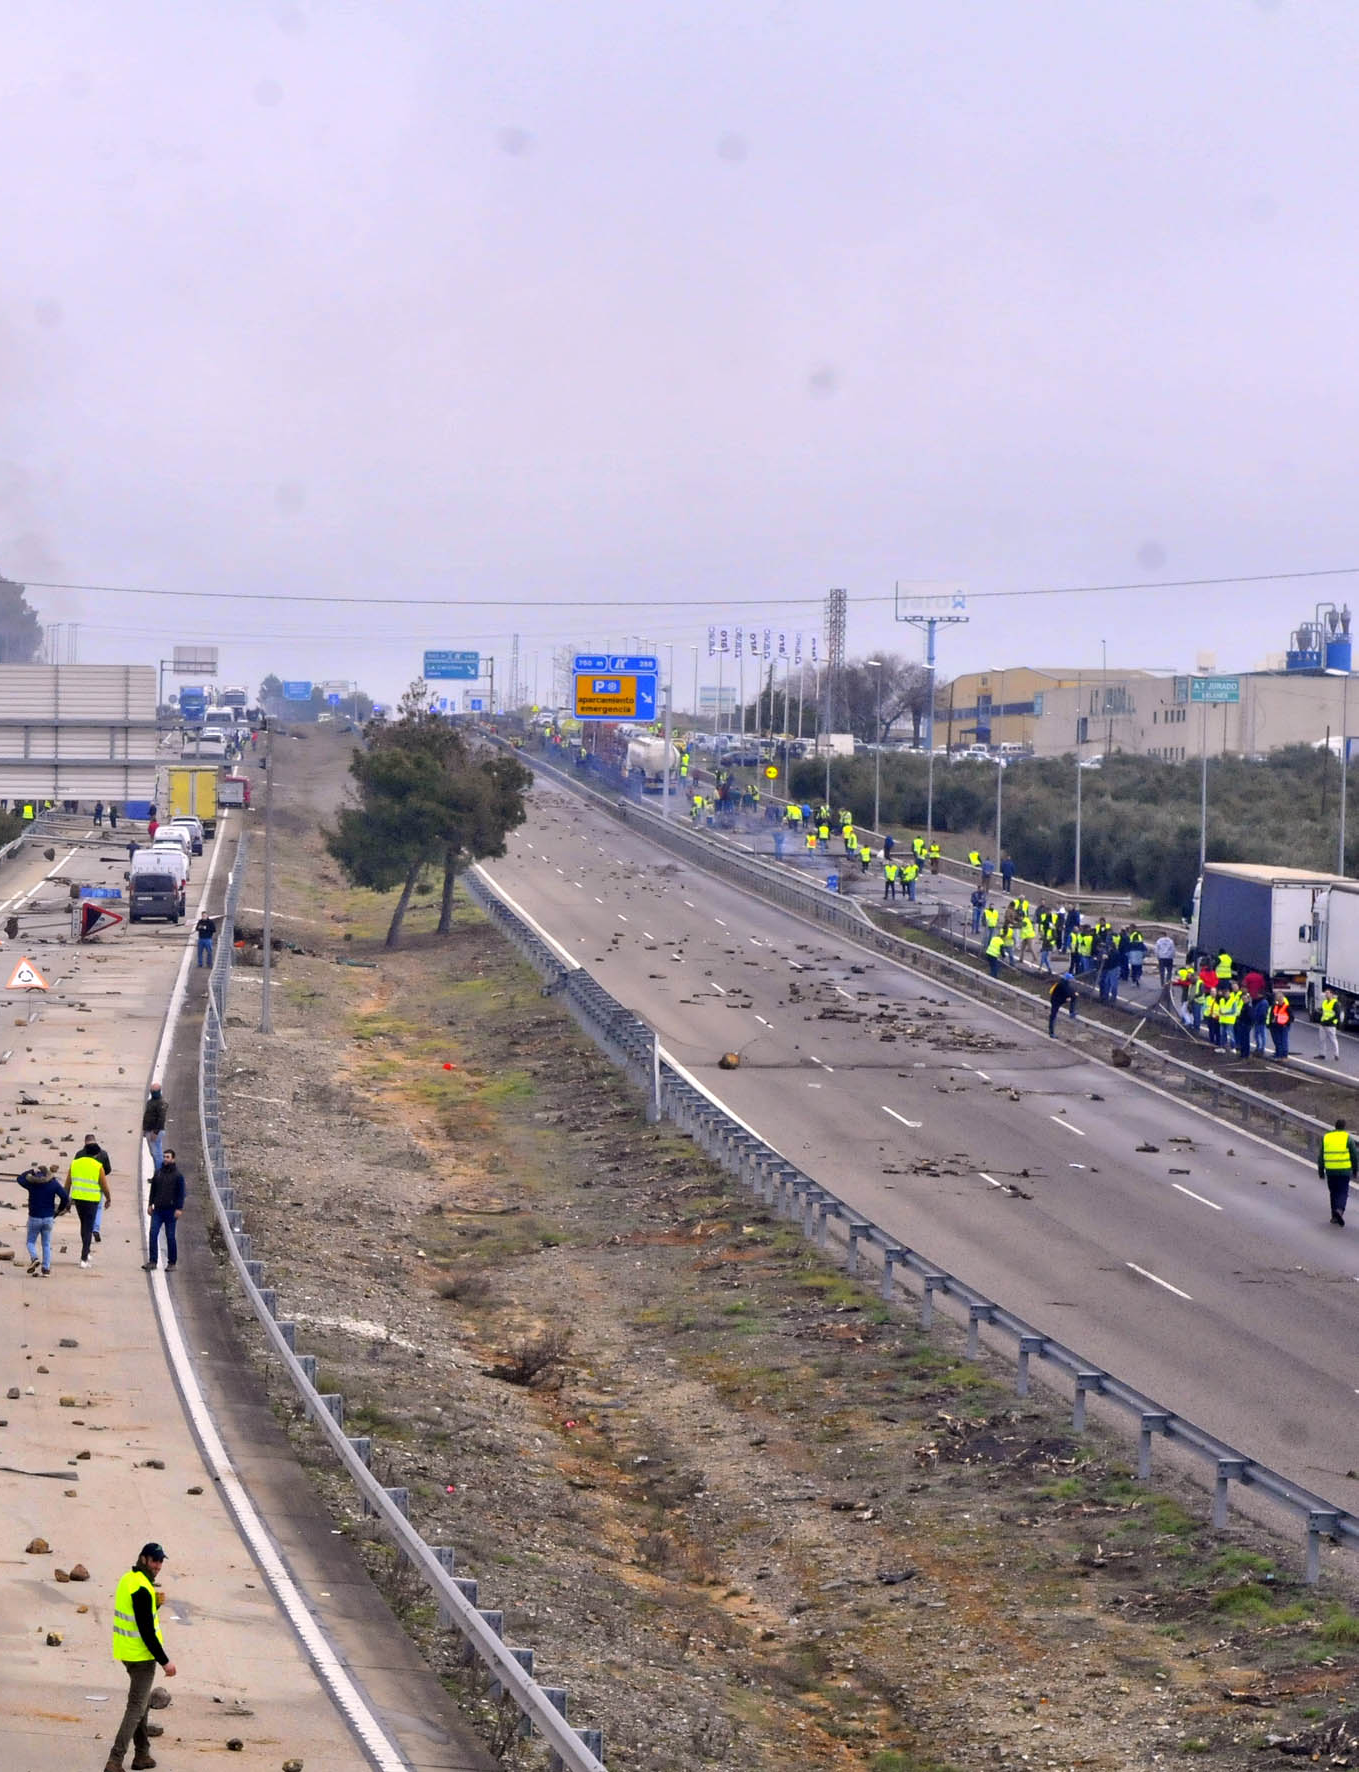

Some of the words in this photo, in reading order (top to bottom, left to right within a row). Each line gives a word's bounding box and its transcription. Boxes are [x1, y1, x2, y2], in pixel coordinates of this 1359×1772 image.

[595, 680, 605, 693] P
[578, 697, 635, 705] aparcamiento
[580, 706, 631, 714] emergencia
